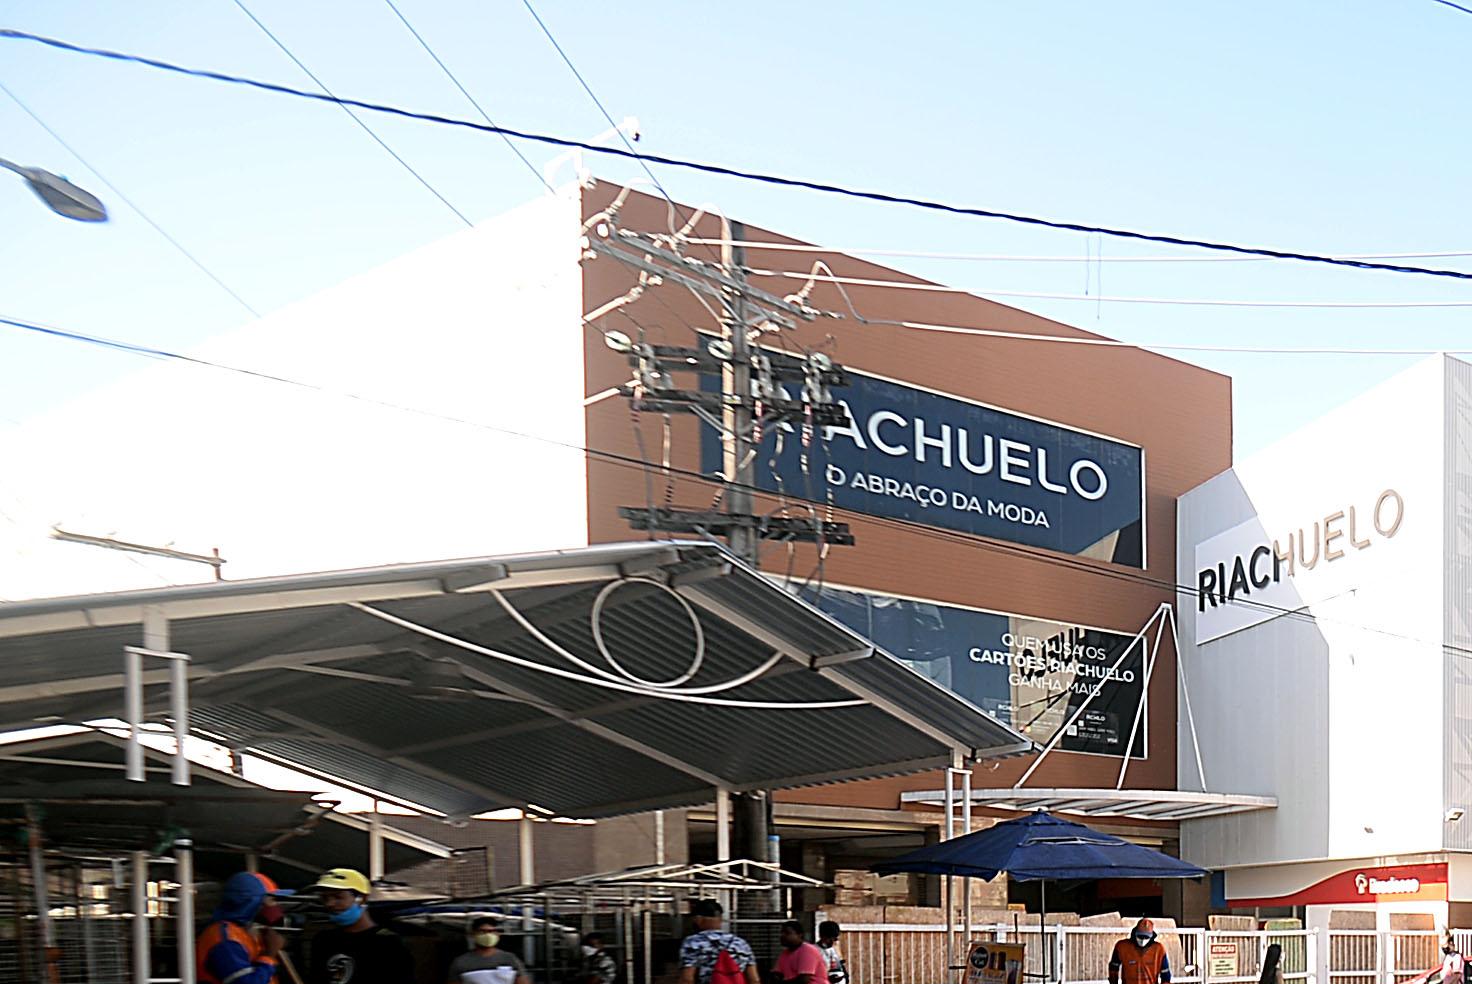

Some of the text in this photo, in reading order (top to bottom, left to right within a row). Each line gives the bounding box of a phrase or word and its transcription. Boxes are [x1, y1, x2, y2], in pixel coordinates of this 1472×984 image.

[850, 469, 948, 508] ABRAÇO
[951, 491, 984, 513] DA
[989, 499, 1051, 530] MODA
[1198, 488, 1405, 613] RIACHUELO
[1001, 632, 1047, 652] QUEM
[1085, 646, 1107, 661] OS
[969, 647, 1135, 683] CARTÕES RIACHUELO
[1008, 673, 1102, 698] GANHA MAIS
